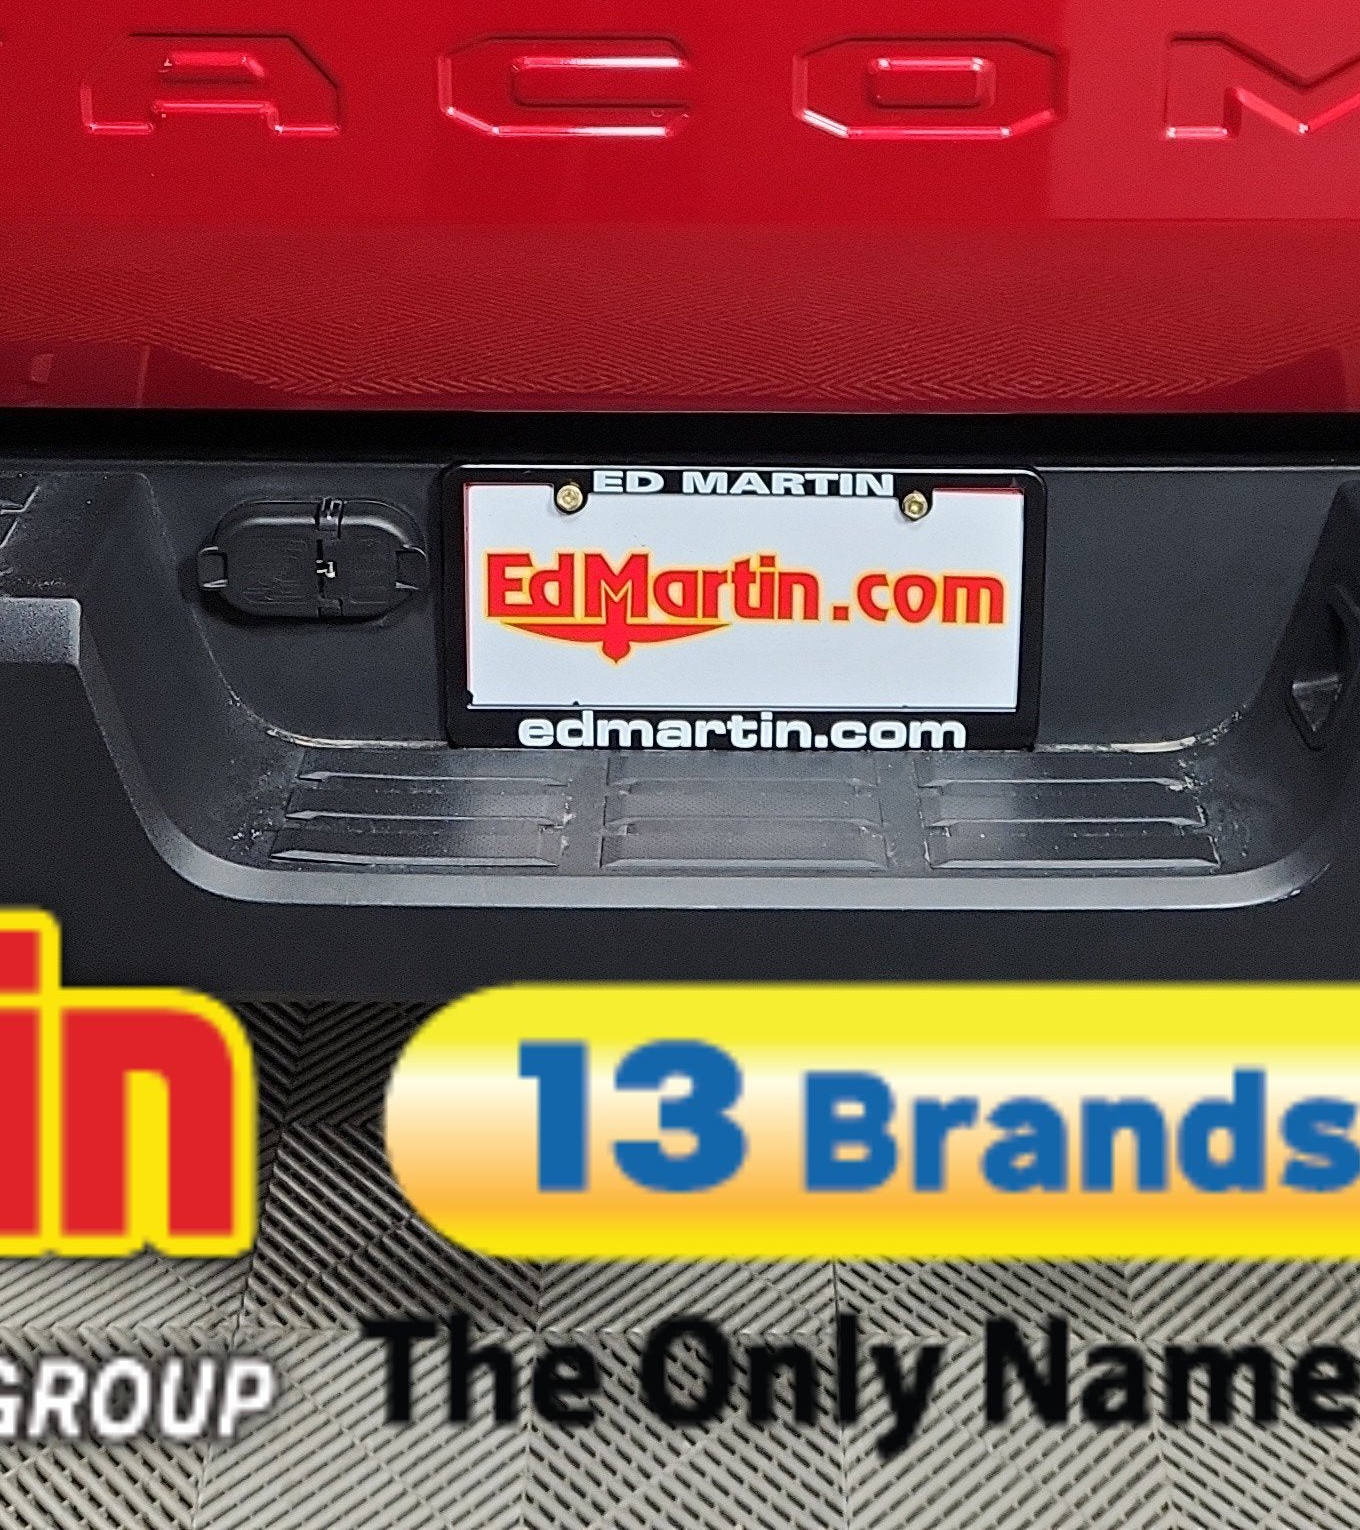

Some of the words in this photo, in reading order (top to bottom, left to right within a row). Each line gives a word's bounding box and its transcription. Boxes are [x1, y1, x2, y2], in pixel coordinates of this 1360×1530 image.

[593, 470, 665, 494] ED
[683, 471, 894, 497] MARTIN
[518, 711, 967, 750] edmartin.com
